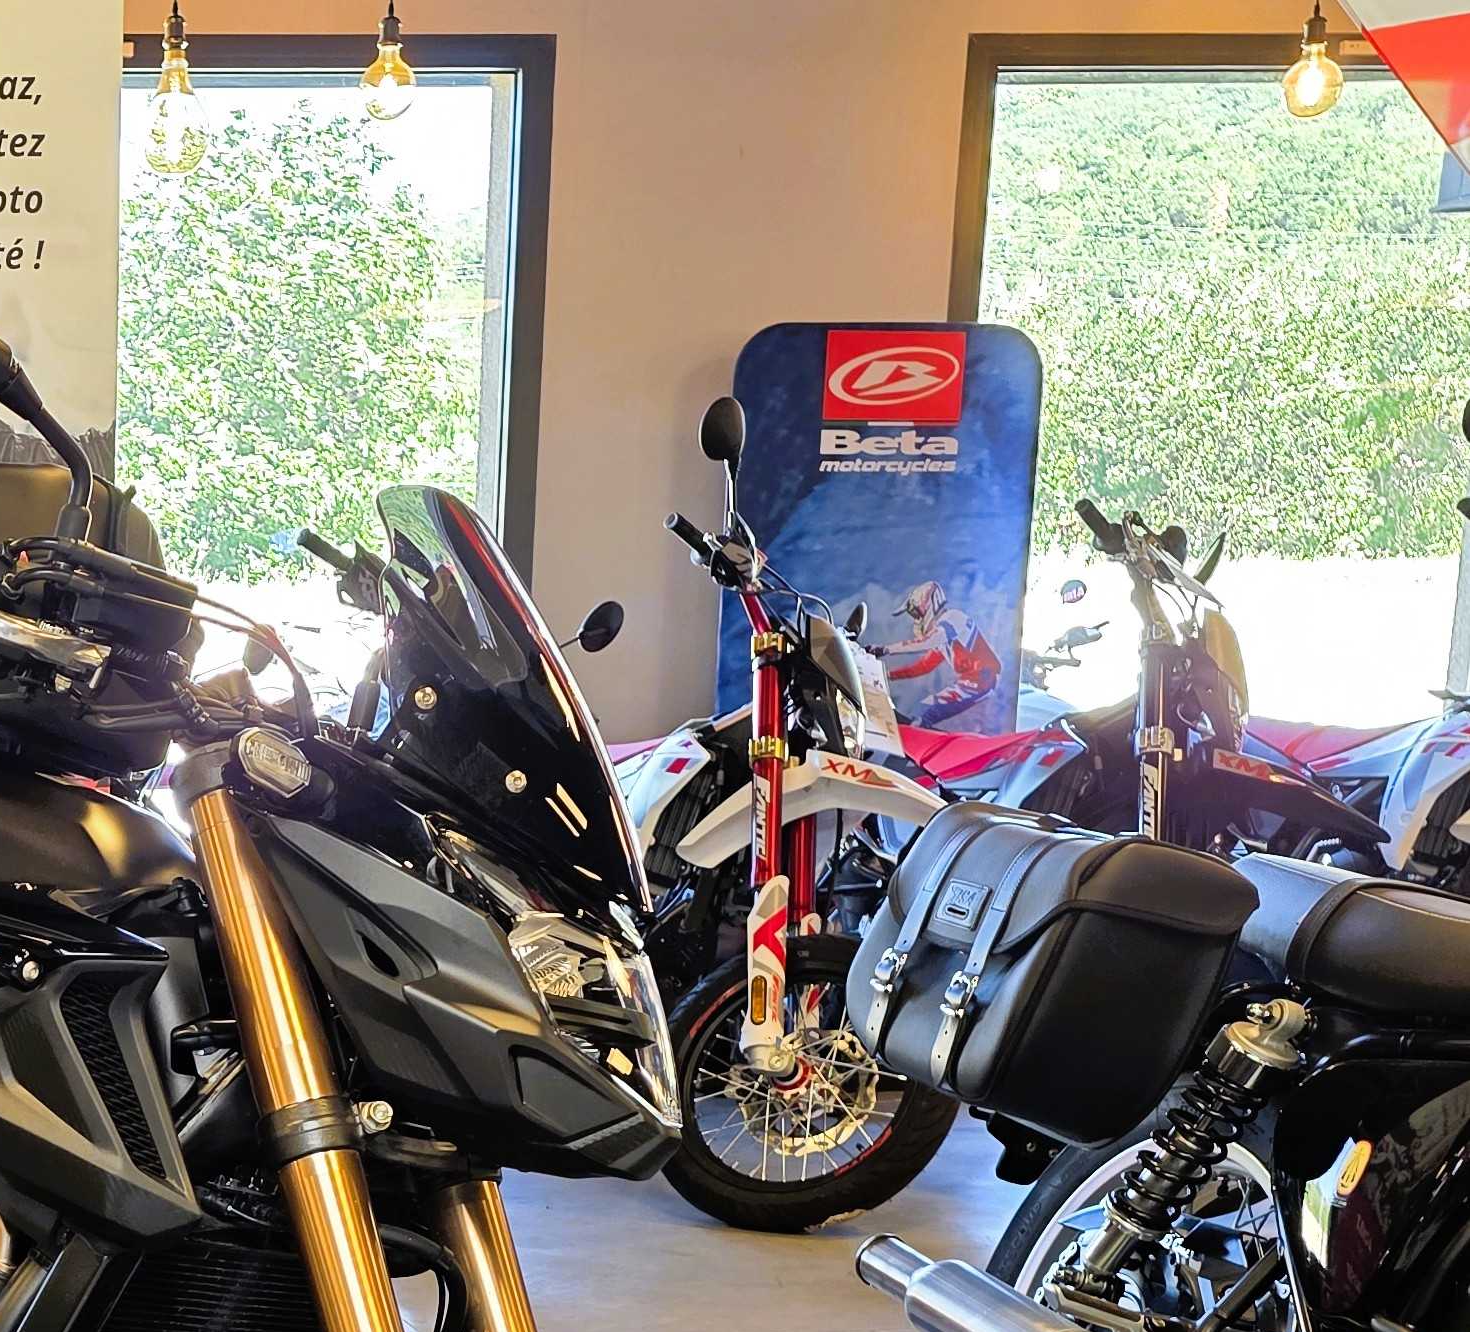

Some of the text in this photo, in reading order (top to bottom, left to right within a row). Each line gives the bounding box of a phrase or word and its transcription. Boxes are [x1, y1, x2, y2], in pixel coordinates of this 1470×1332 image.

[819, 429, 959, 455] Beta
[819, 458, 957, 476] motorcycles
[1140, 761, 1158, 840] FANTI
